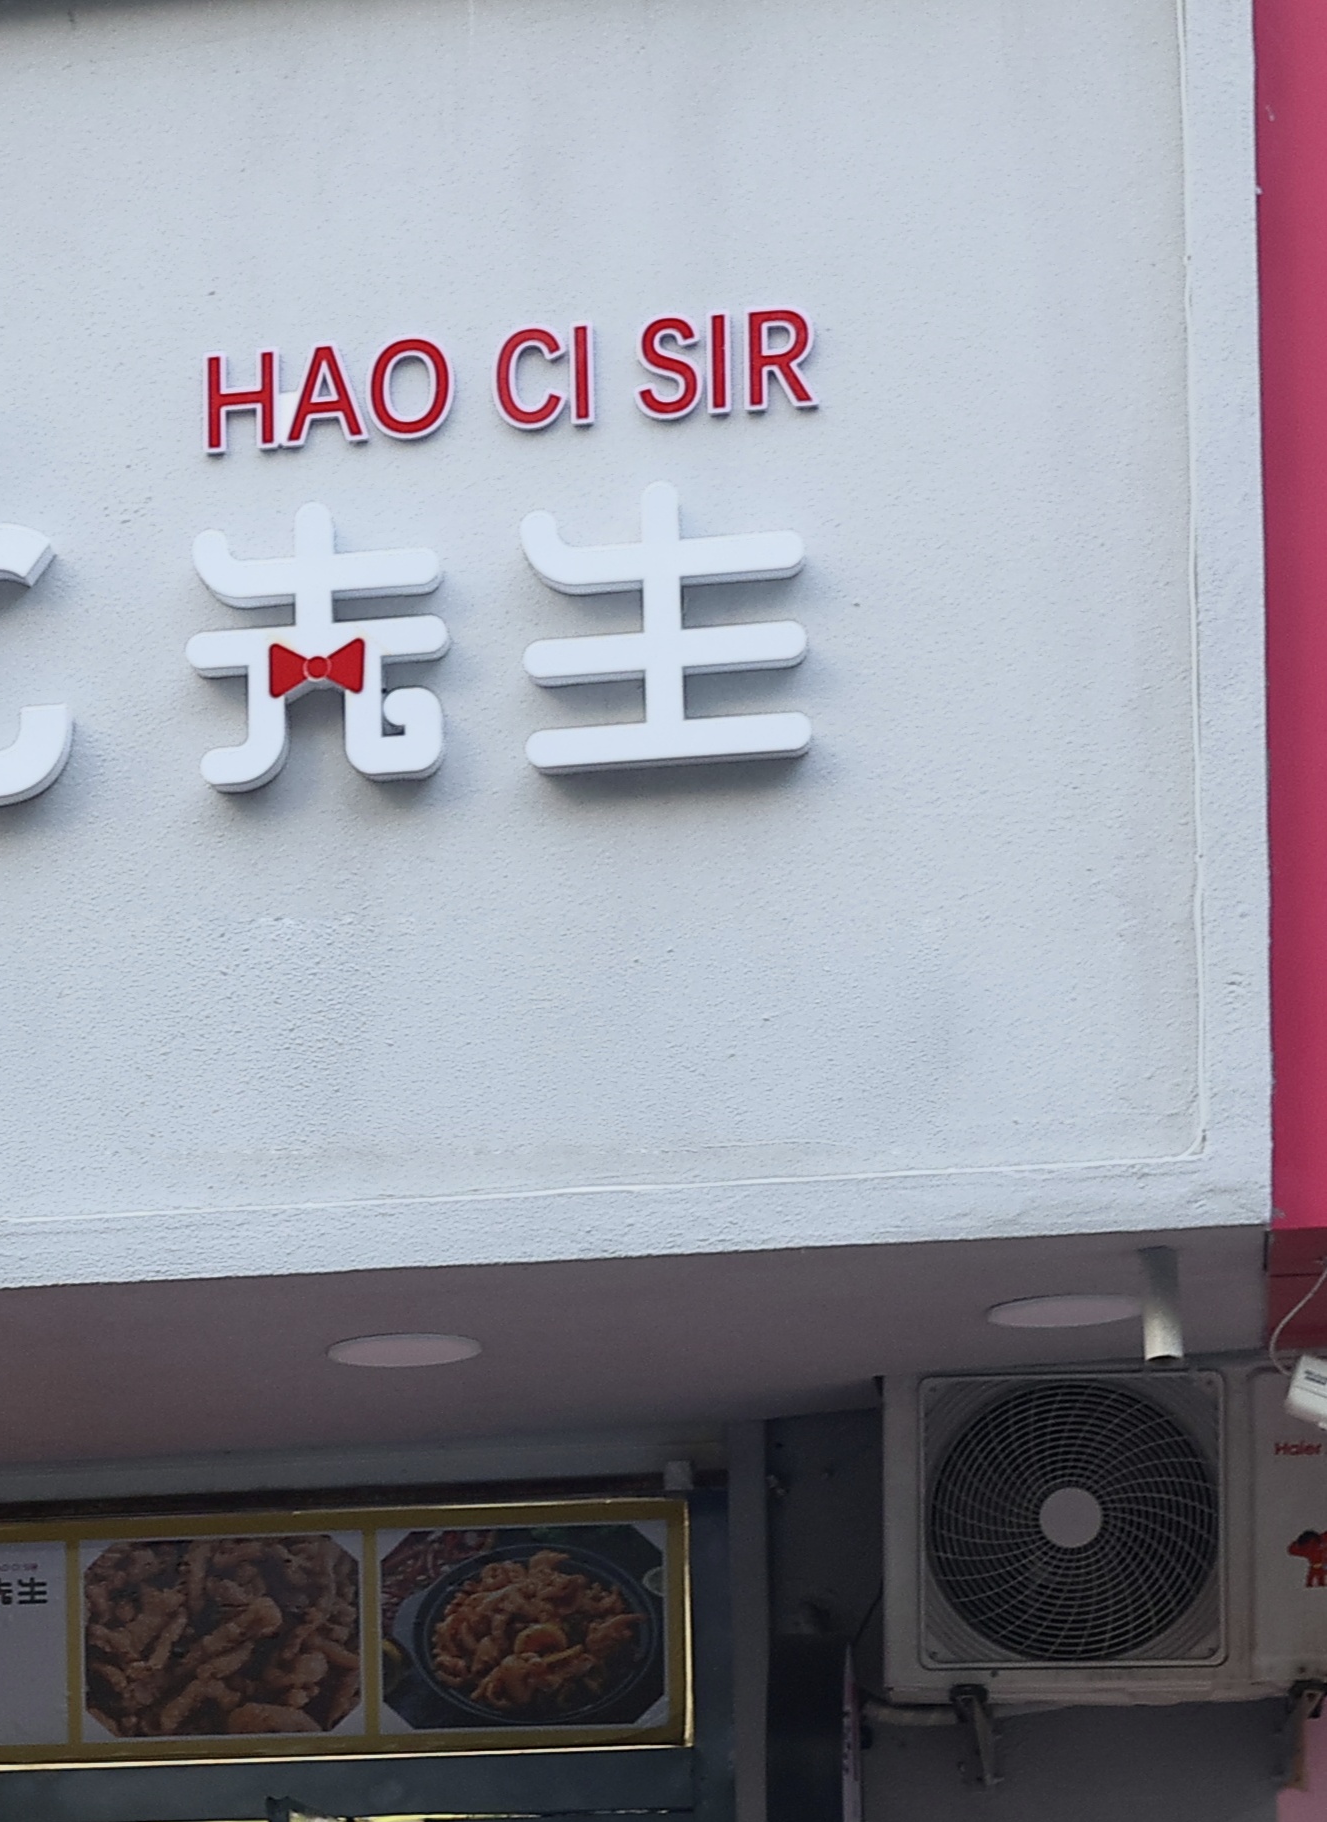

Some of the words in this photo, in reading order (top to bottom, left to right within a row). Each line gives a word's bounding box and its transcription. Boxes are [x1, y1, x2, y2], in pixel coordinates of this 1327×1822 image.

[204, 334, 453, 454] HAO
[493, 321, 596, 430] CI
[635, 303, 818, 421] SIR
[1275, 1441, 1321, 1455] Haier
